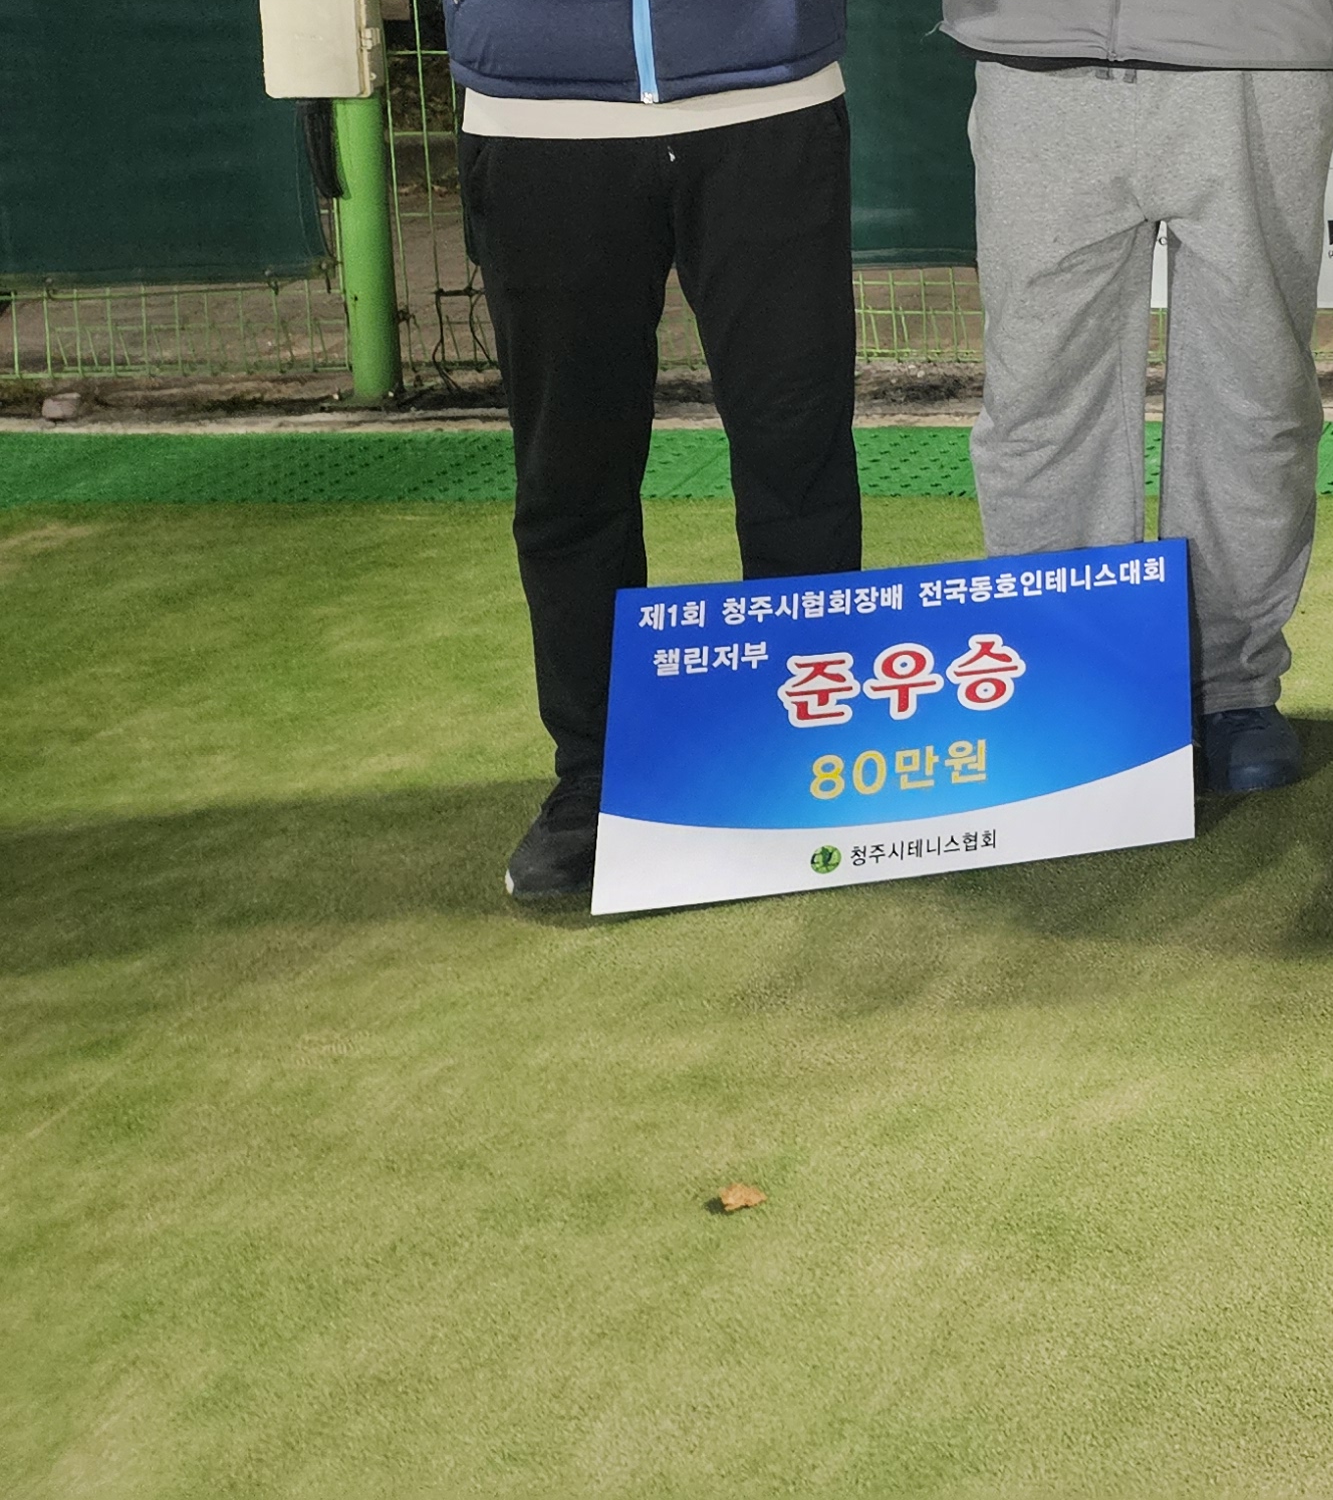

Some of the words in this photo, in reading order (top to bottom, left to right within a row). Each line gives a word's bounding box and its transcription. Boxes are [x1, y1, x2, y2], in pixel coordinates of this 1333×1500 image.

[639, 601, 706, 631] 제1회
[722, 583, 904, 625] 청주시협회장배
[919, 556, 1166, 607] 전국동호인테니스대회
[653, 641, 769, 676] 챌린저부
[779, 635, 1025, 727] 준우승
[810, 738, 988, 800] 80만원
[850, 828, 997, 866] 청주시테니스협회
